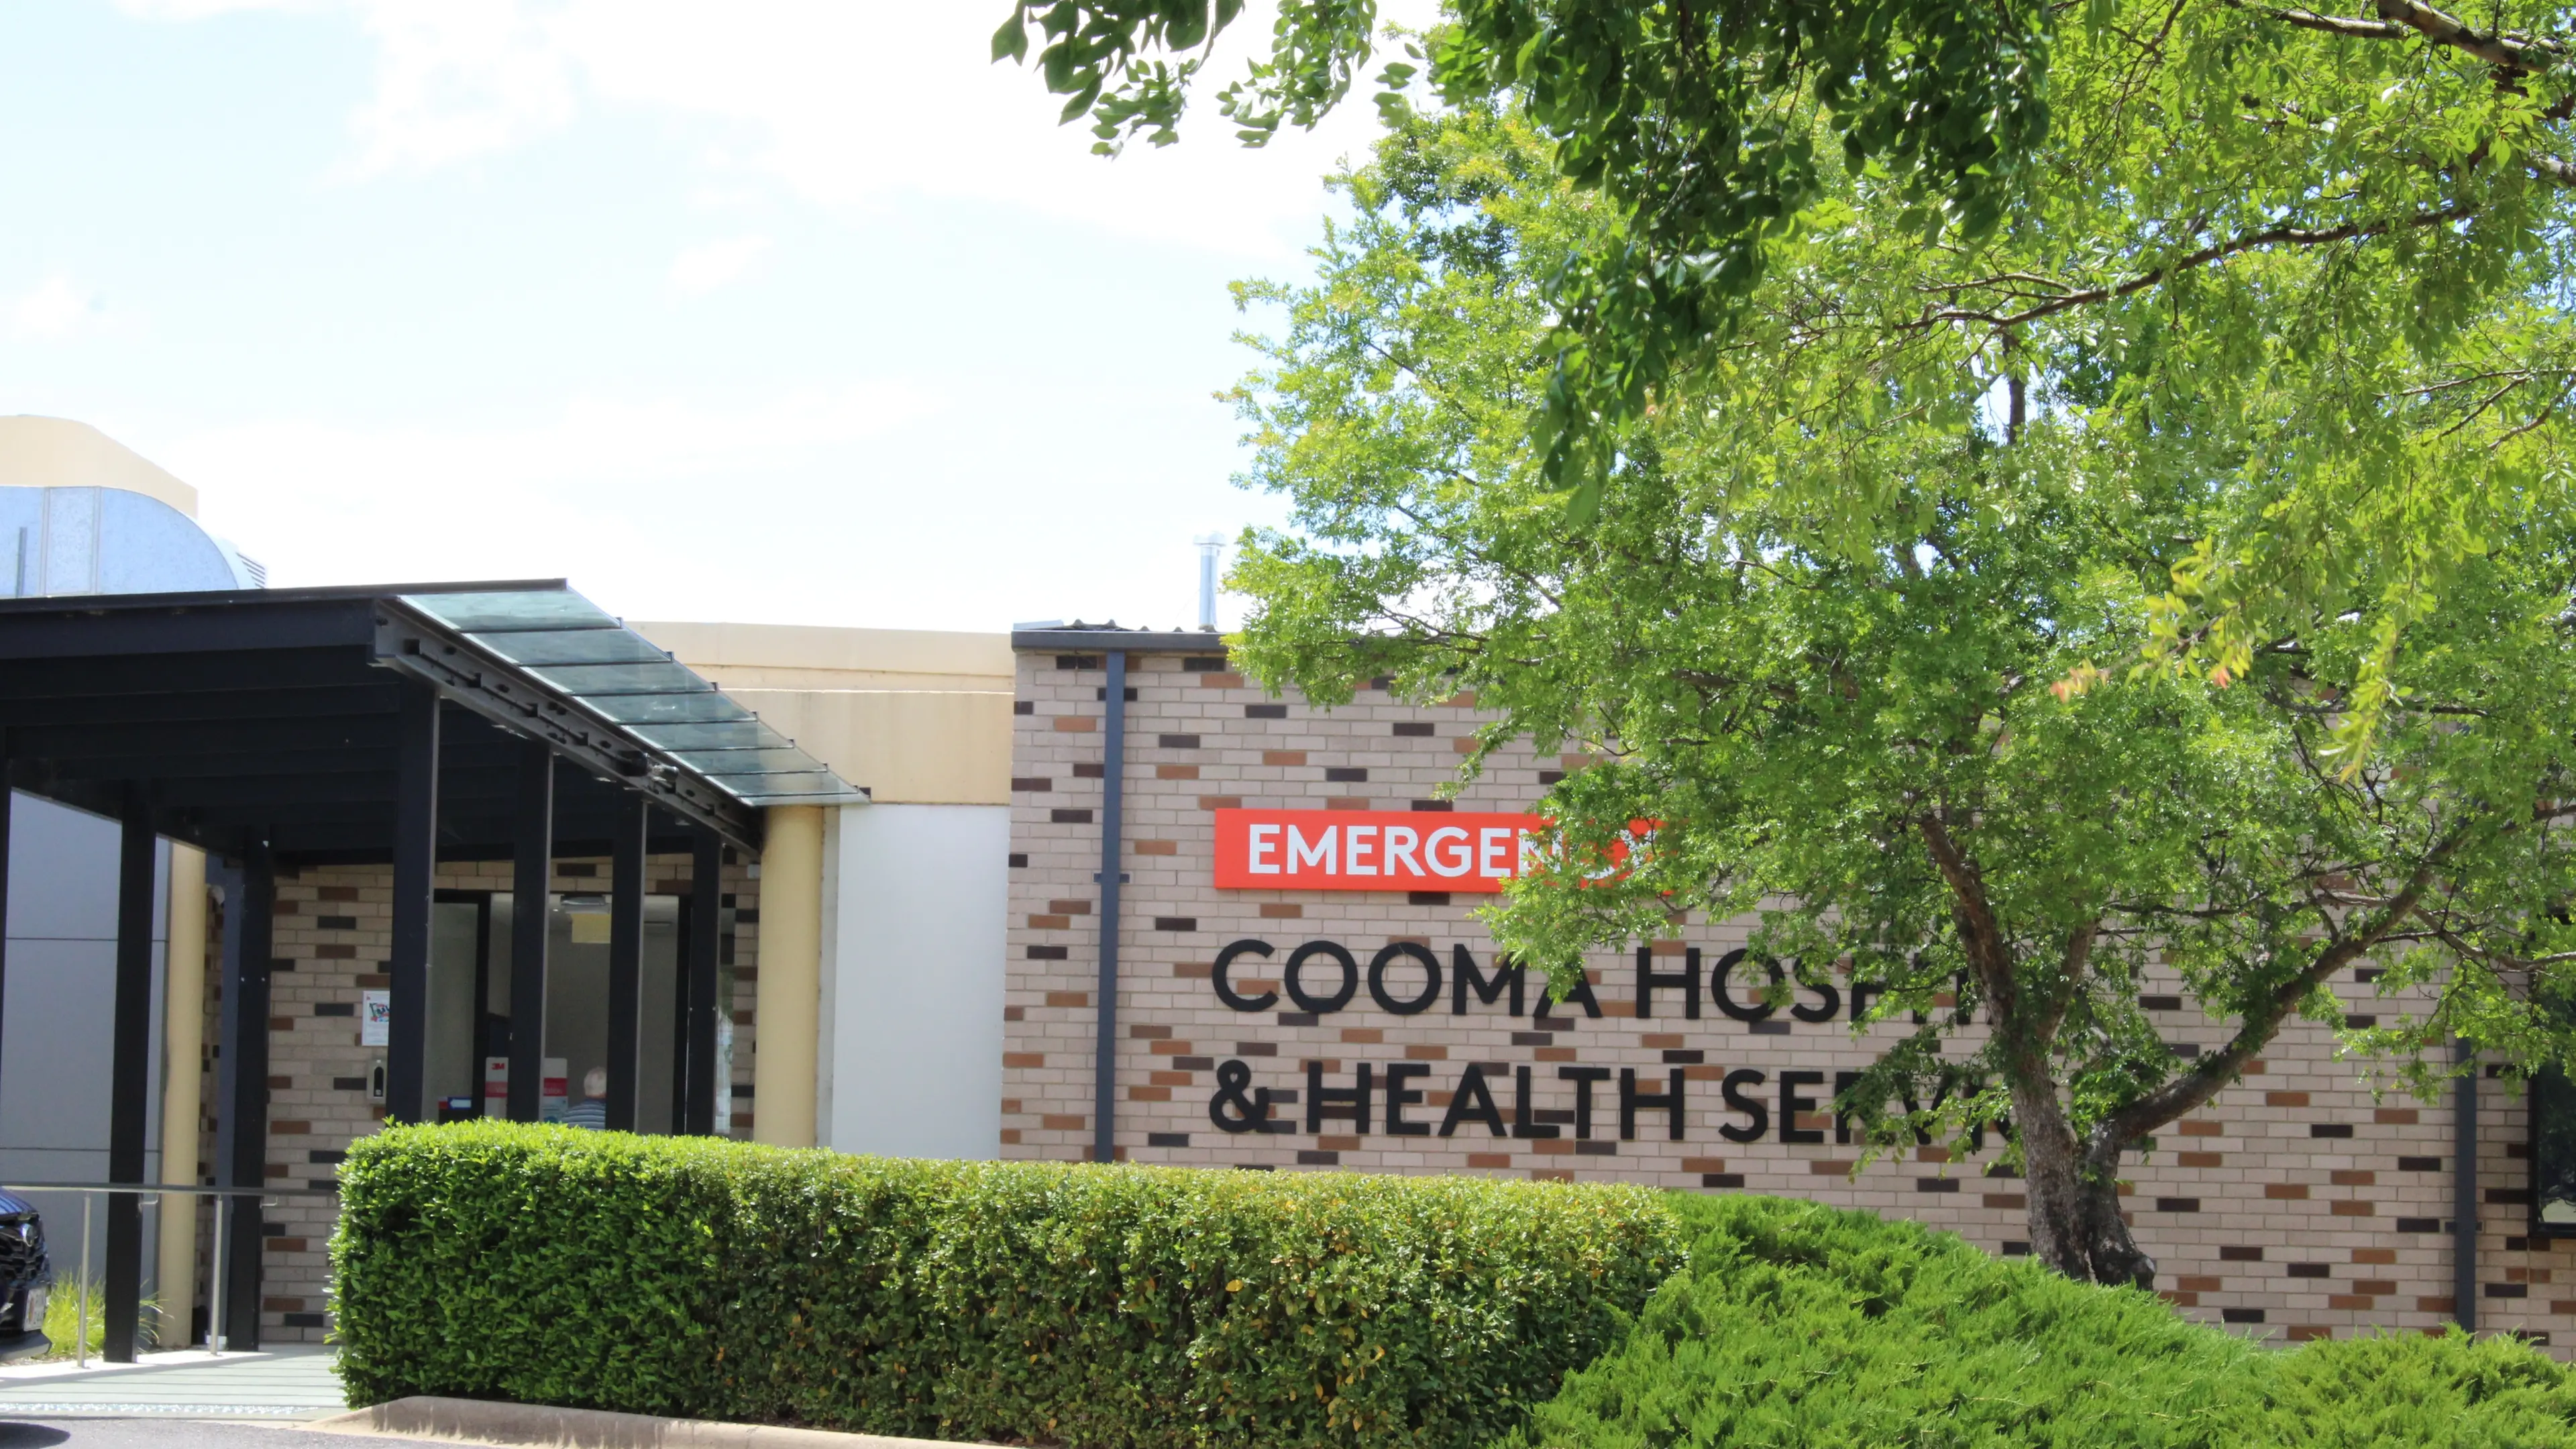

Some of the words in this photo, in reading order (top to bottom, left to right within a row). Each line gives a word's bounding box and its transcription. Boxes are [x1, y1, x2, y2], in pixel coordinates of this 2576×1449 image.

[1212, 939, 1603, 1018] COOMA
[491, 1063, 505, 1071] 3M
[1209, 1059, 1271, 1134] &
[1306, 1061, 1685, 1141] HEALTH
